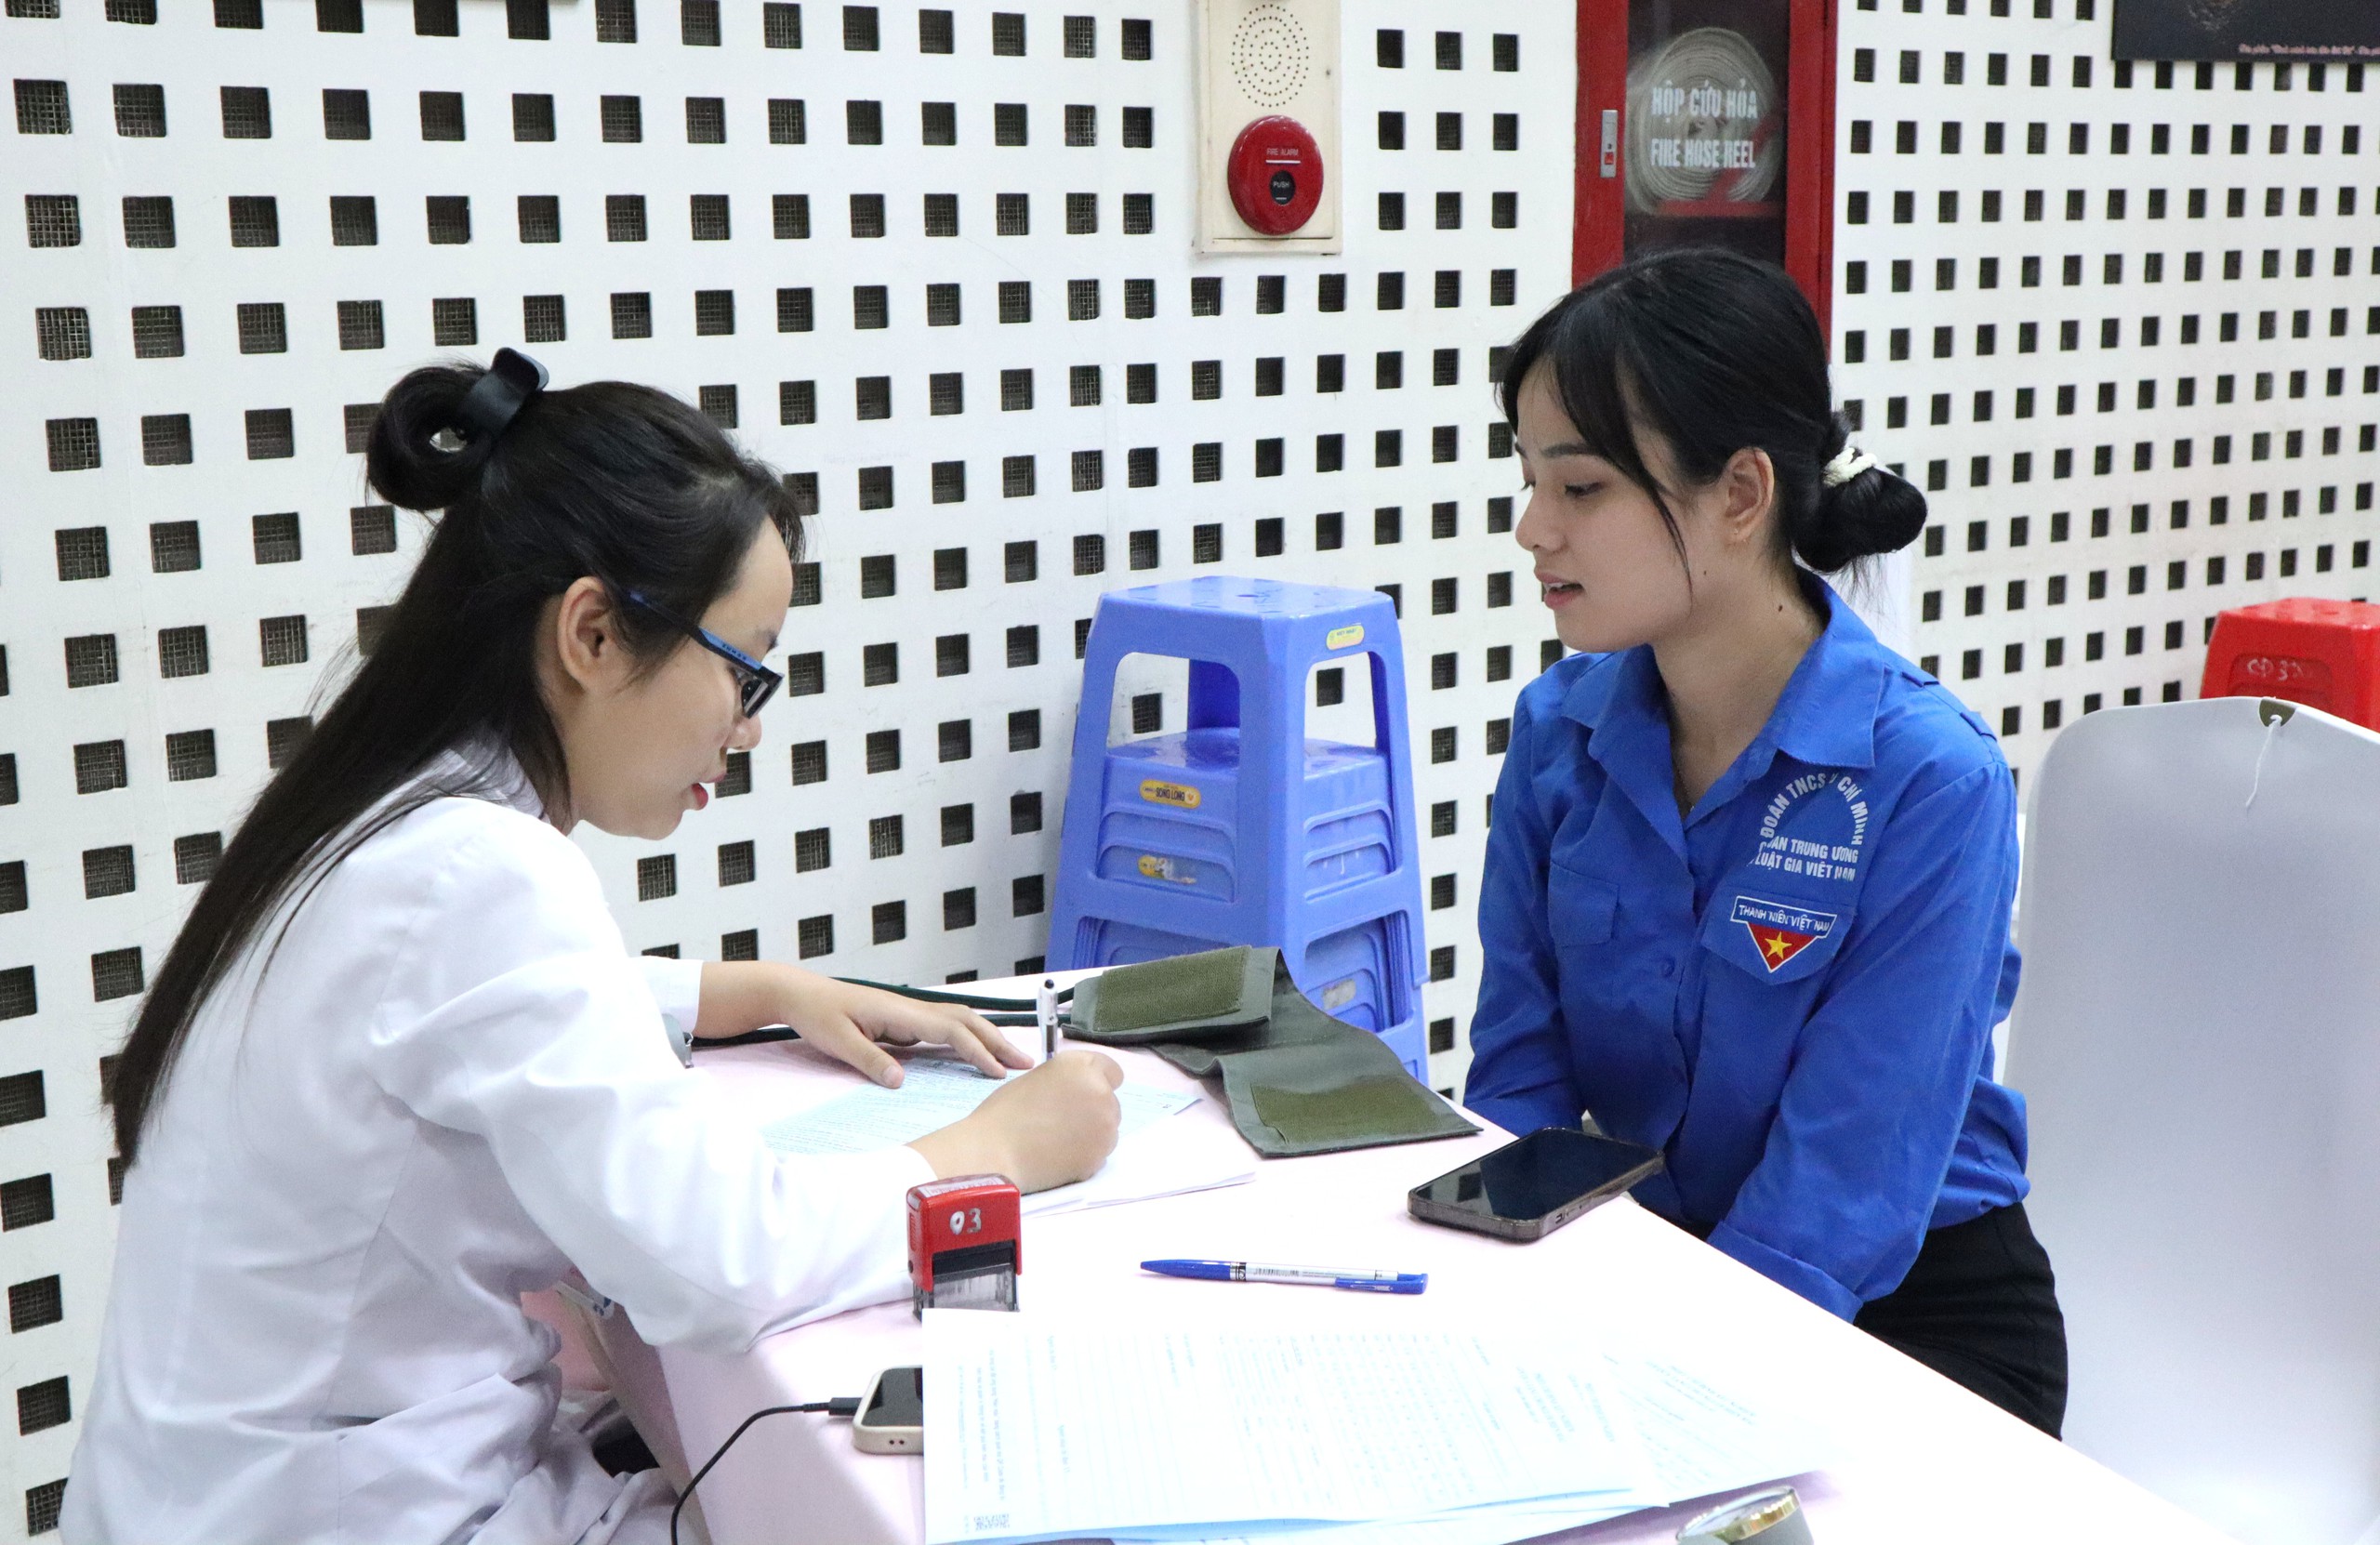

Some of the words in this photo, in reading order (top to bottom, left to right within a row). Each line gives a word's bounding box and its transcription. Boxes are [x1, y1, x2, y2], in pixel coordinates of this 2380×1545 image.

[1651, 79, 1685, 124] HỘP
[1726, 78, 1758, 118] HỎA
[1280, 148, 1299, 156] ALARM
[1651, 139, 1681, 167] FIRE
[1685, 139, 1720, 167] HOSE
[1724, 139, 1756, 168] REEL
[1760, 793, 1791, 839] ĐOÀN
[1785, 772, 1827, 799] TNCS
[1837, 776, 1863, 803] CHÍ
[1850, 800, 1869, 846] MINH
[1790, 839, 1829, 860] TRUNG
[1831, 845, 1859, 864] ƯƠNG
[1754, 852, 1783, 871] LUẬT
[1783, 857, 1803, 874] GIA
[1834, 866, 1856, 881] NAM
[1739, 904, 1767, 920] THANH
[1768, 909, 1790, 925] NIÊN
[1791, 914, 1813, 931] VIỆT
[1814, 919, 1831, 931] NAM
[948, 1207, 983, 1235] 03
